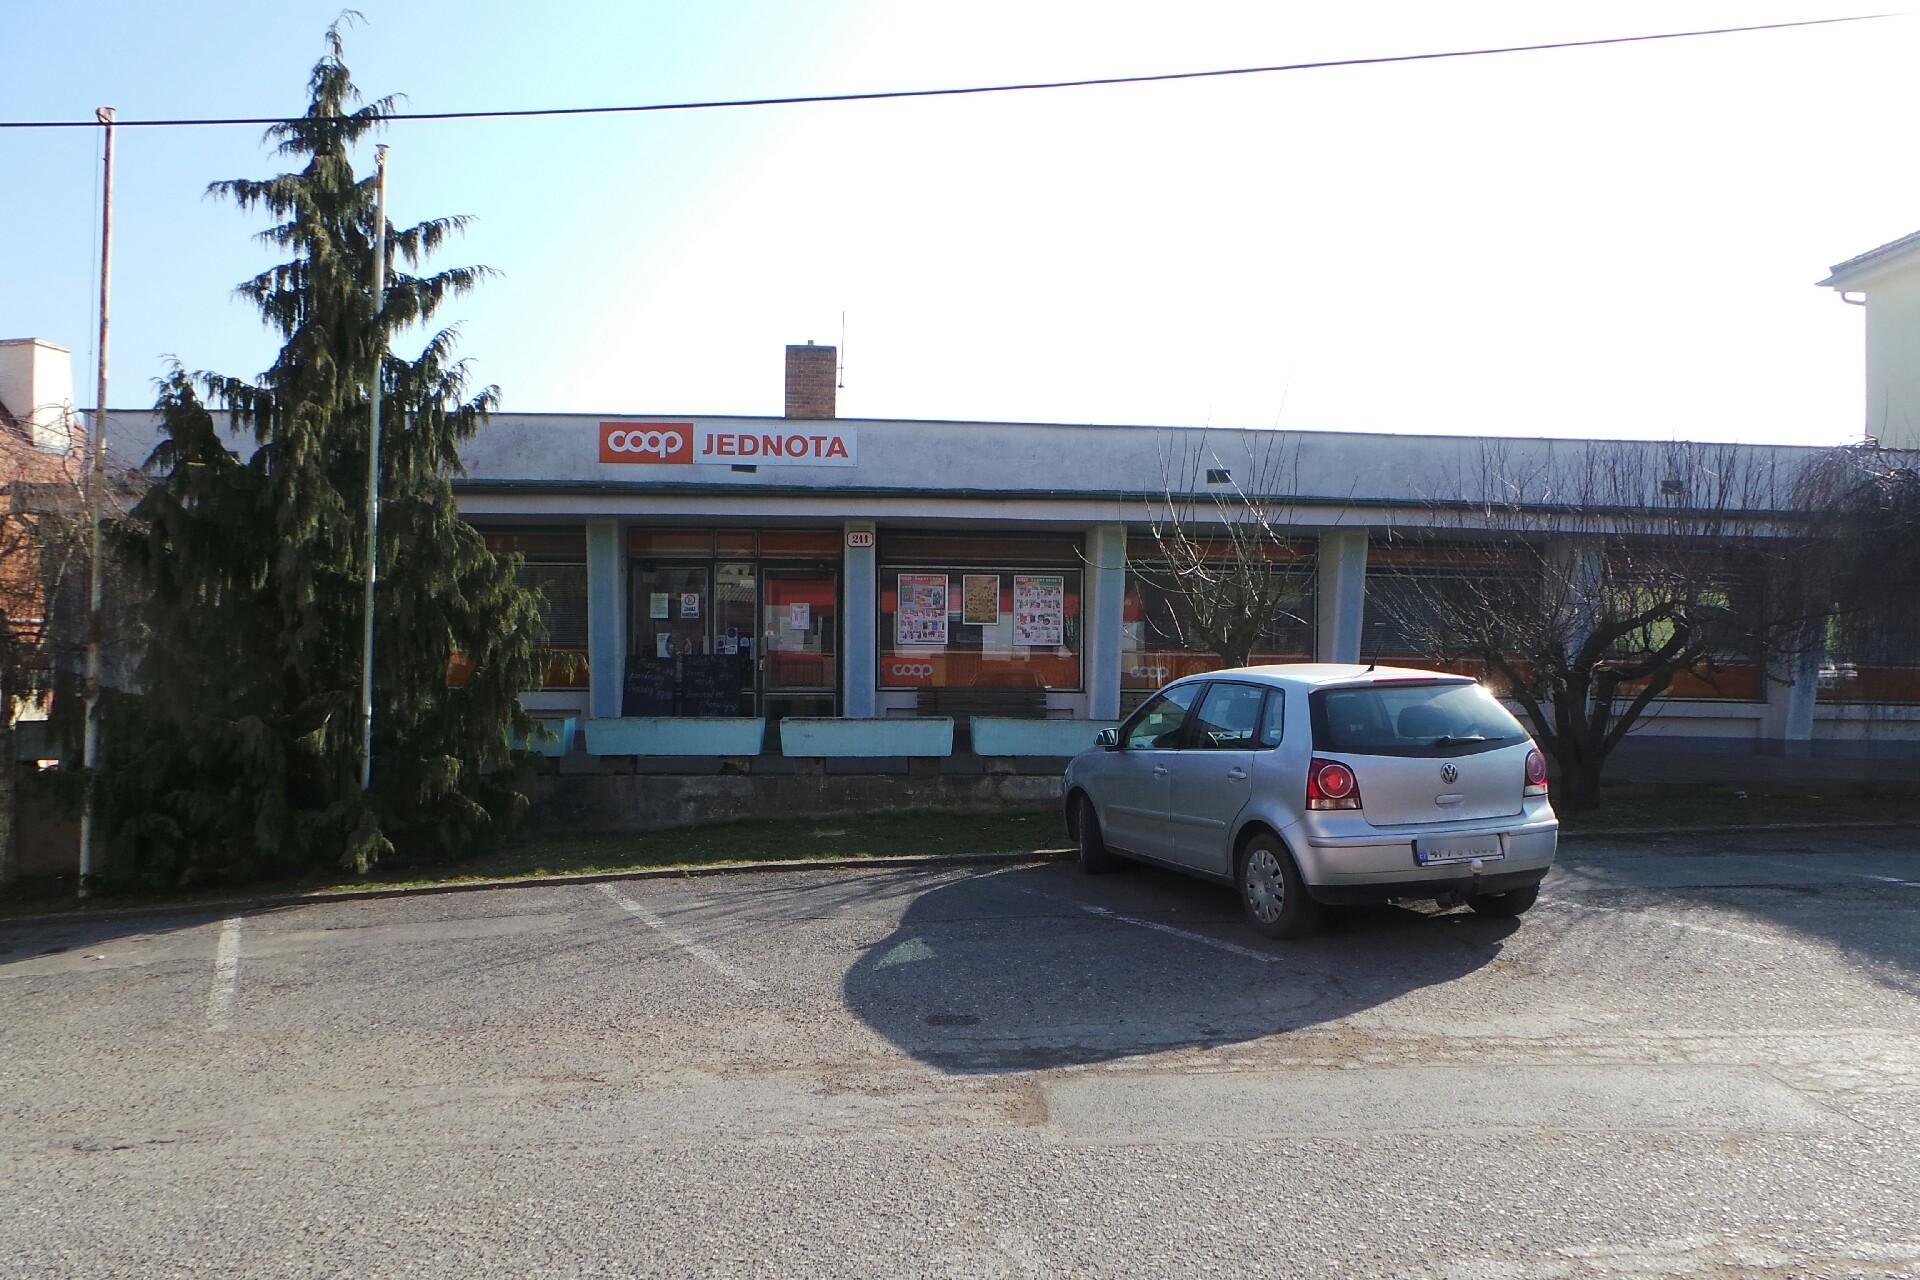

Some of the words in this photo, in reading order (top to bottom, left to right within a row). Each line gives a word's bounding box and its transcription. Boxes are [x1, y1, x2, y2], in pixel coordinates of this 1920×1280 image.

[608, 430, 683, 458] coop
[702, 434, 849, 458] JEDNOTA
[852, 534, 869, 544] 211
[892, 664, 933, 678] coop
